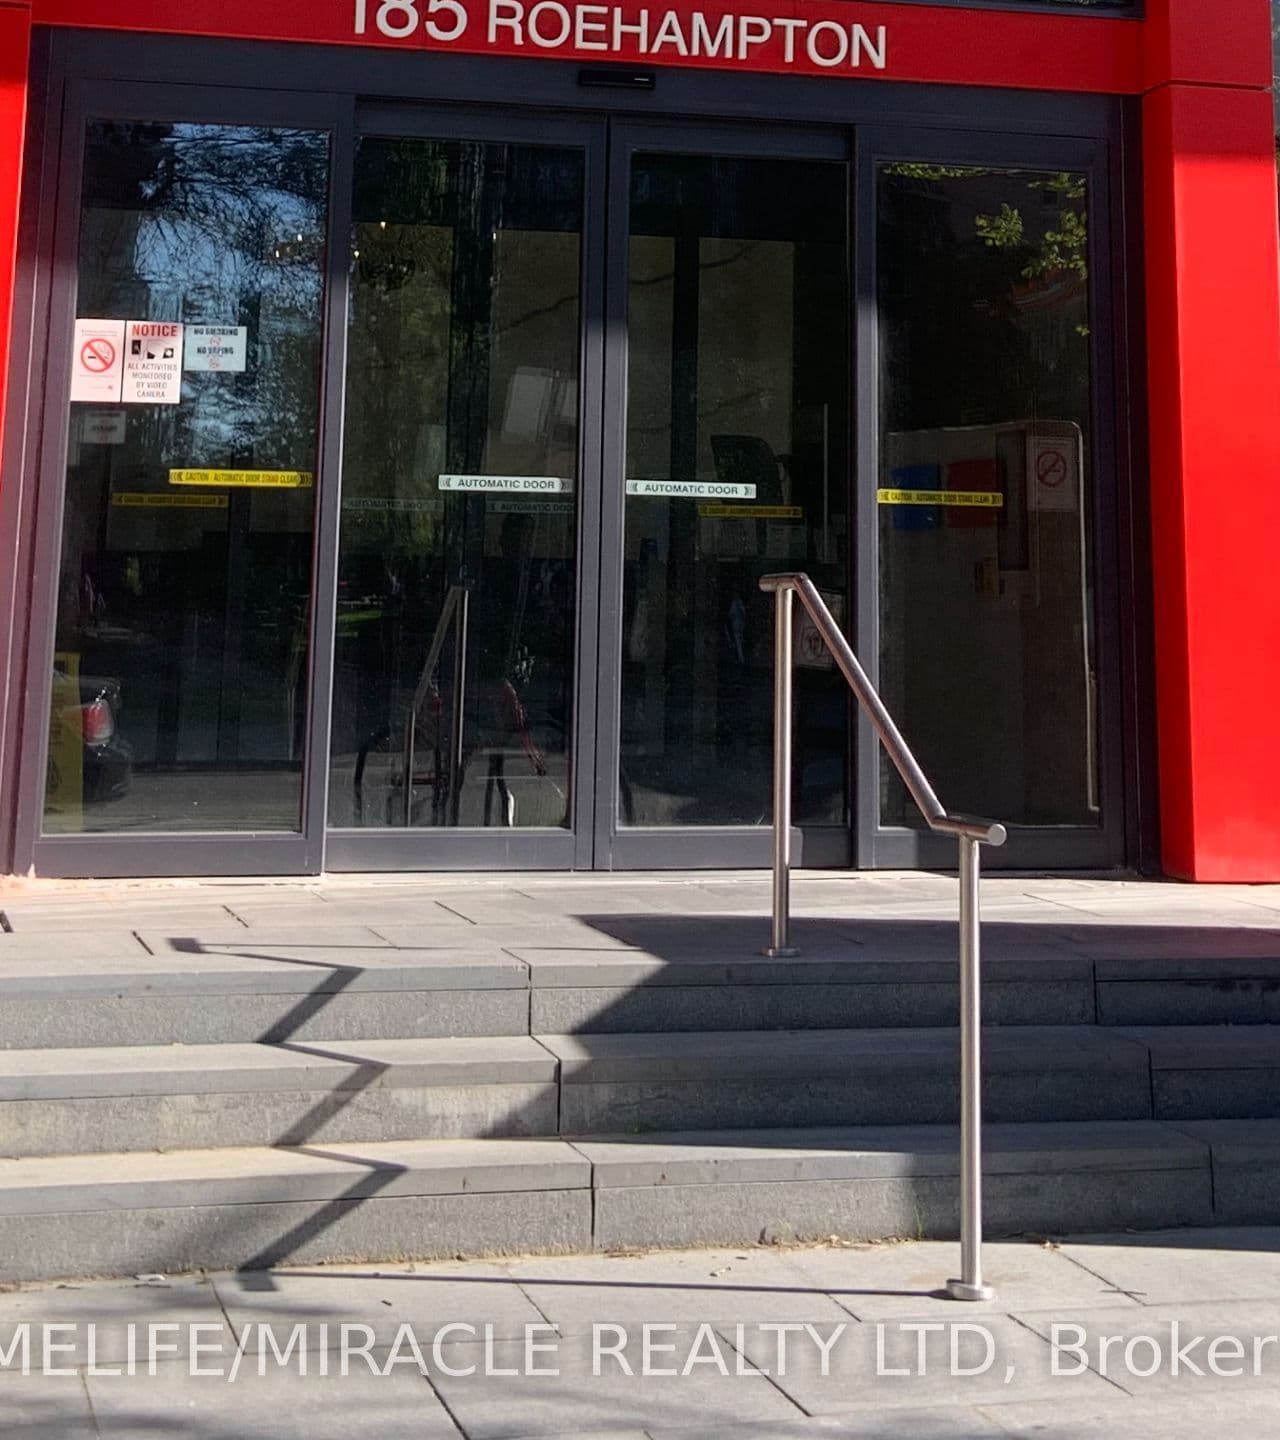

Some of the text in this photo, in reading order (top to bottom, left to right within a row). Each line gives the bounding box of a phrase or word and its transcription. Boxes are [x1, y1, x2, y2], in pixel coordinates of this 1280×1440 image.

[131, 324, 178, 337] NOTICE
[127, 363, 178, 372] ALL ACTIVITIES
[146, 381, 167, 390] VIDEO
[457, 478, 555, 491] AUTOMATIC DOOR
[644, 483, 738, 496] AUTOMATIC DOOR
